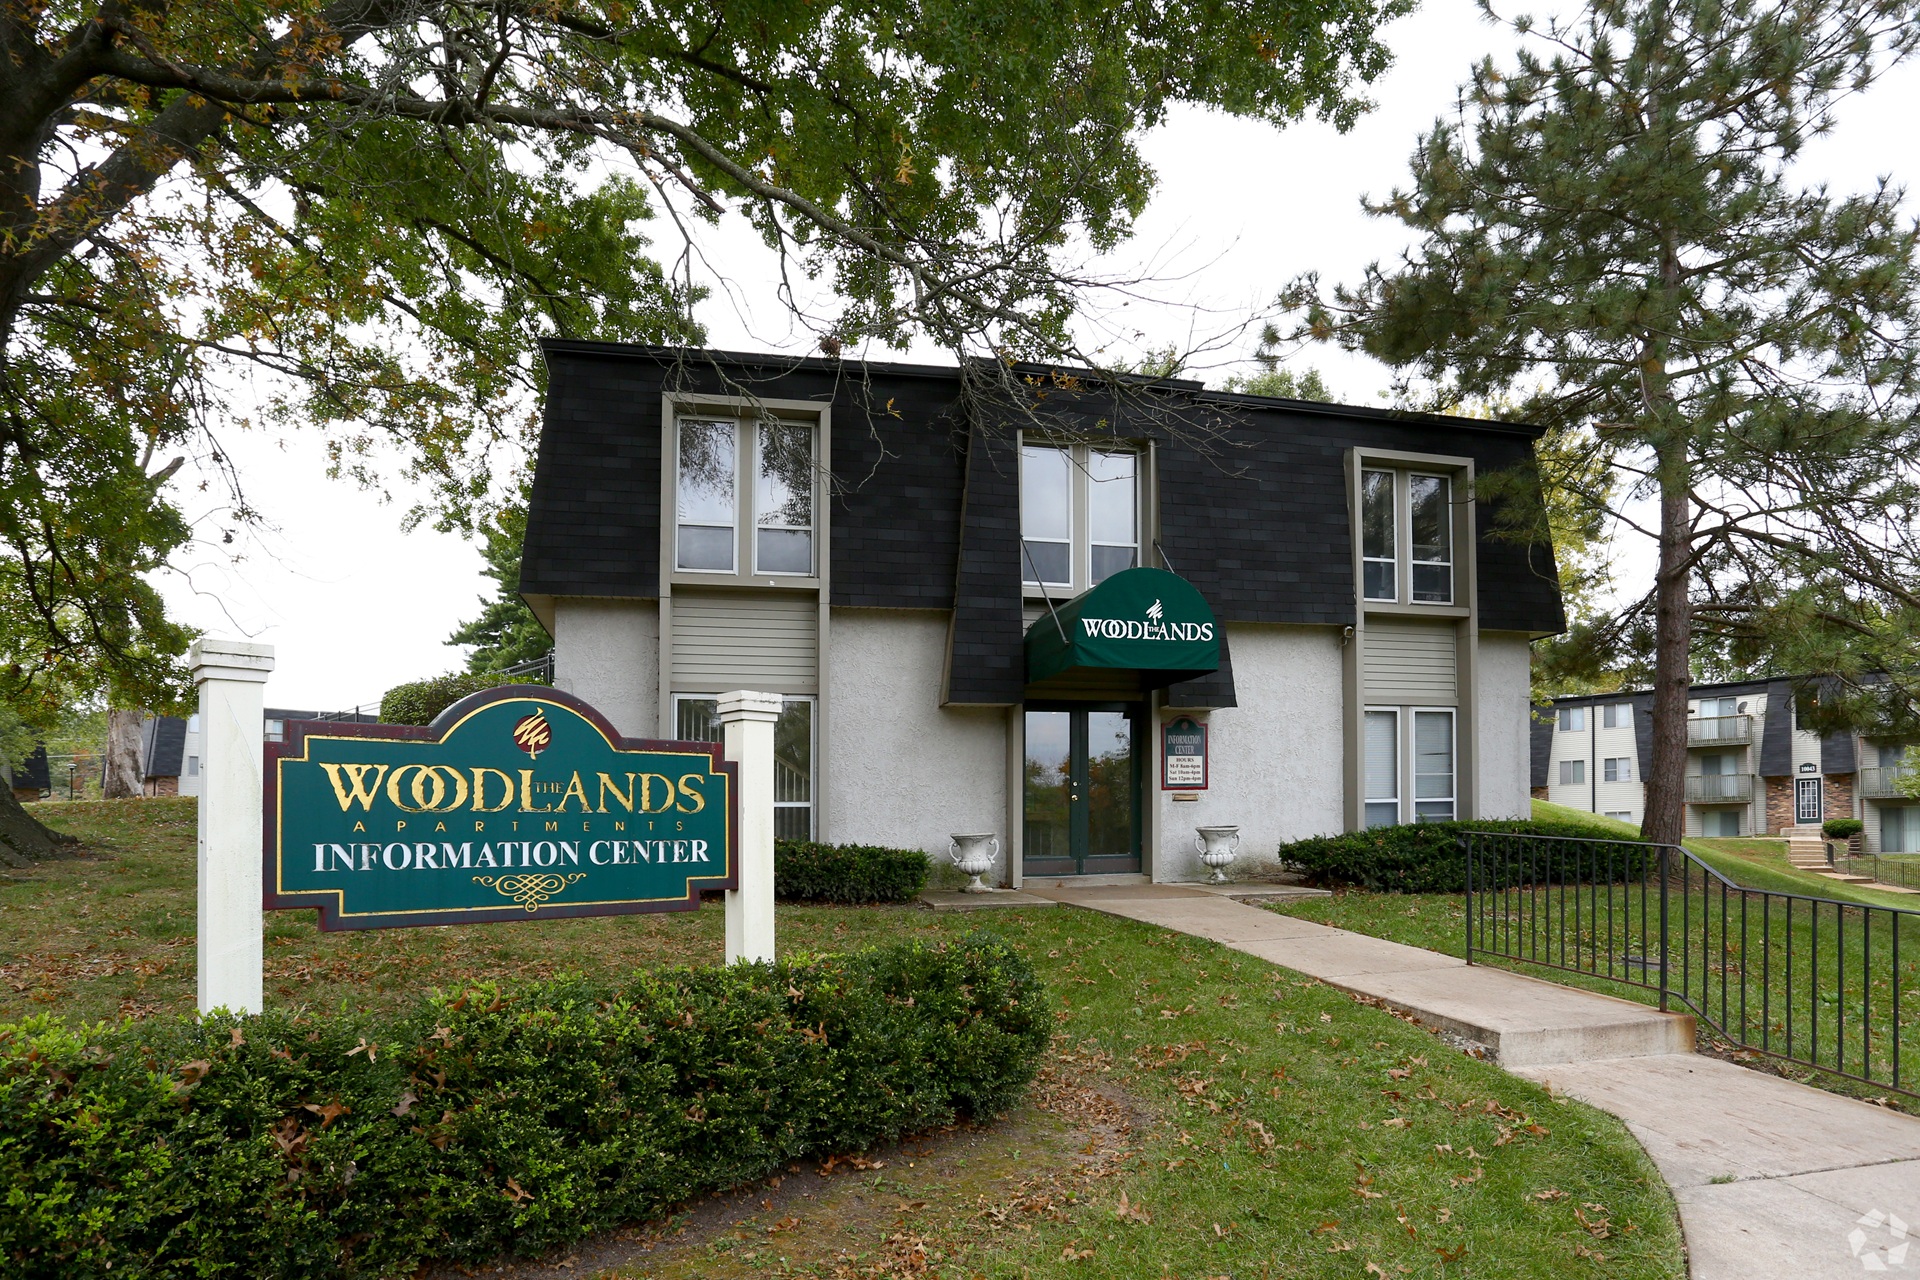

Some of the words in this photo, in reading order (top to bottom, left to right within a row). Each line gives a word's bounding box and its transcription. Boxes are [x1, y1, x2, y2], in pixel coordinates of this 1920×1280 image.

[1081, 618, 1213, 641] WOODLANDS
[1168, 735, 1201, 744] INFORMATION
[1175, 745, 1195, 754] CENTER
[318, 762, 706, 814] WOODLANDS
[534, 781, 565, 794] THE
[353, 820, 684, 833] APARTMENTS
[312, 840, 581, 872] INFORMATION
[589, 839, 711, 866] CENTER
